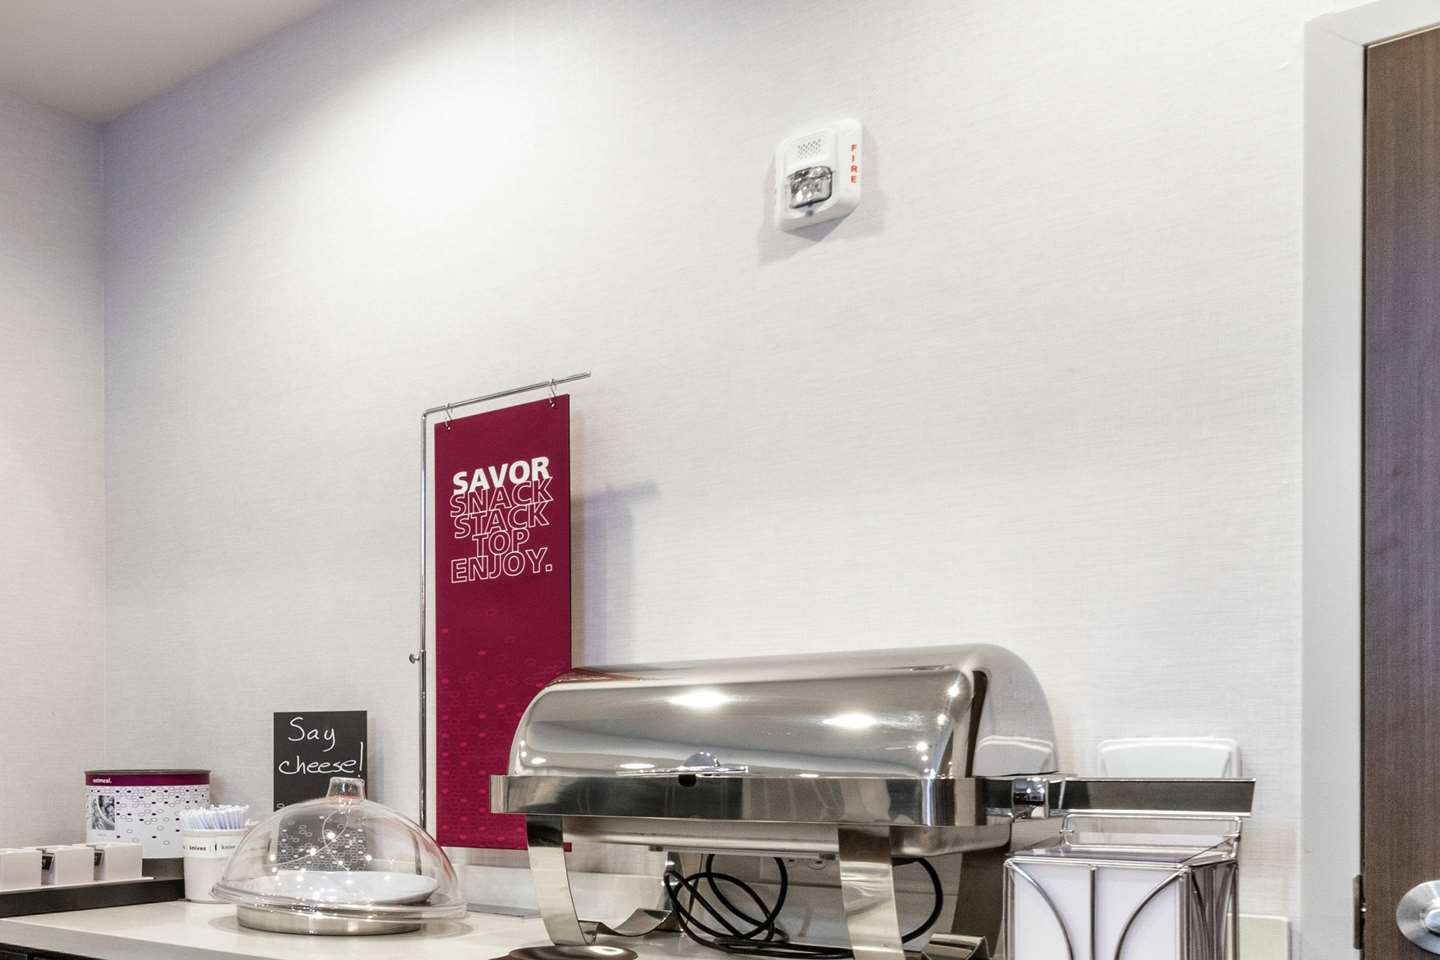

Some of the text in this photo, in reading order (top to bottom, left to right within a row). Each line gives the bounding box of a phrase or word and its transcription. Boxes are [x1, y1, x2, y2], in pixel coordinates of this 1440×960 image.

[850, 143, 858, 184] FIRE
[452, 456, 550, 495] SAVOR
[449, 476, 554, 518] SNACK
[454, 501, 550, 539] STACK
[471, 528, 530, 558] TOP
[450, 547, 553, 584] ENJOY.
[287, 716, 336, 752] Say
[278, 741, 364, 778] cheese!
